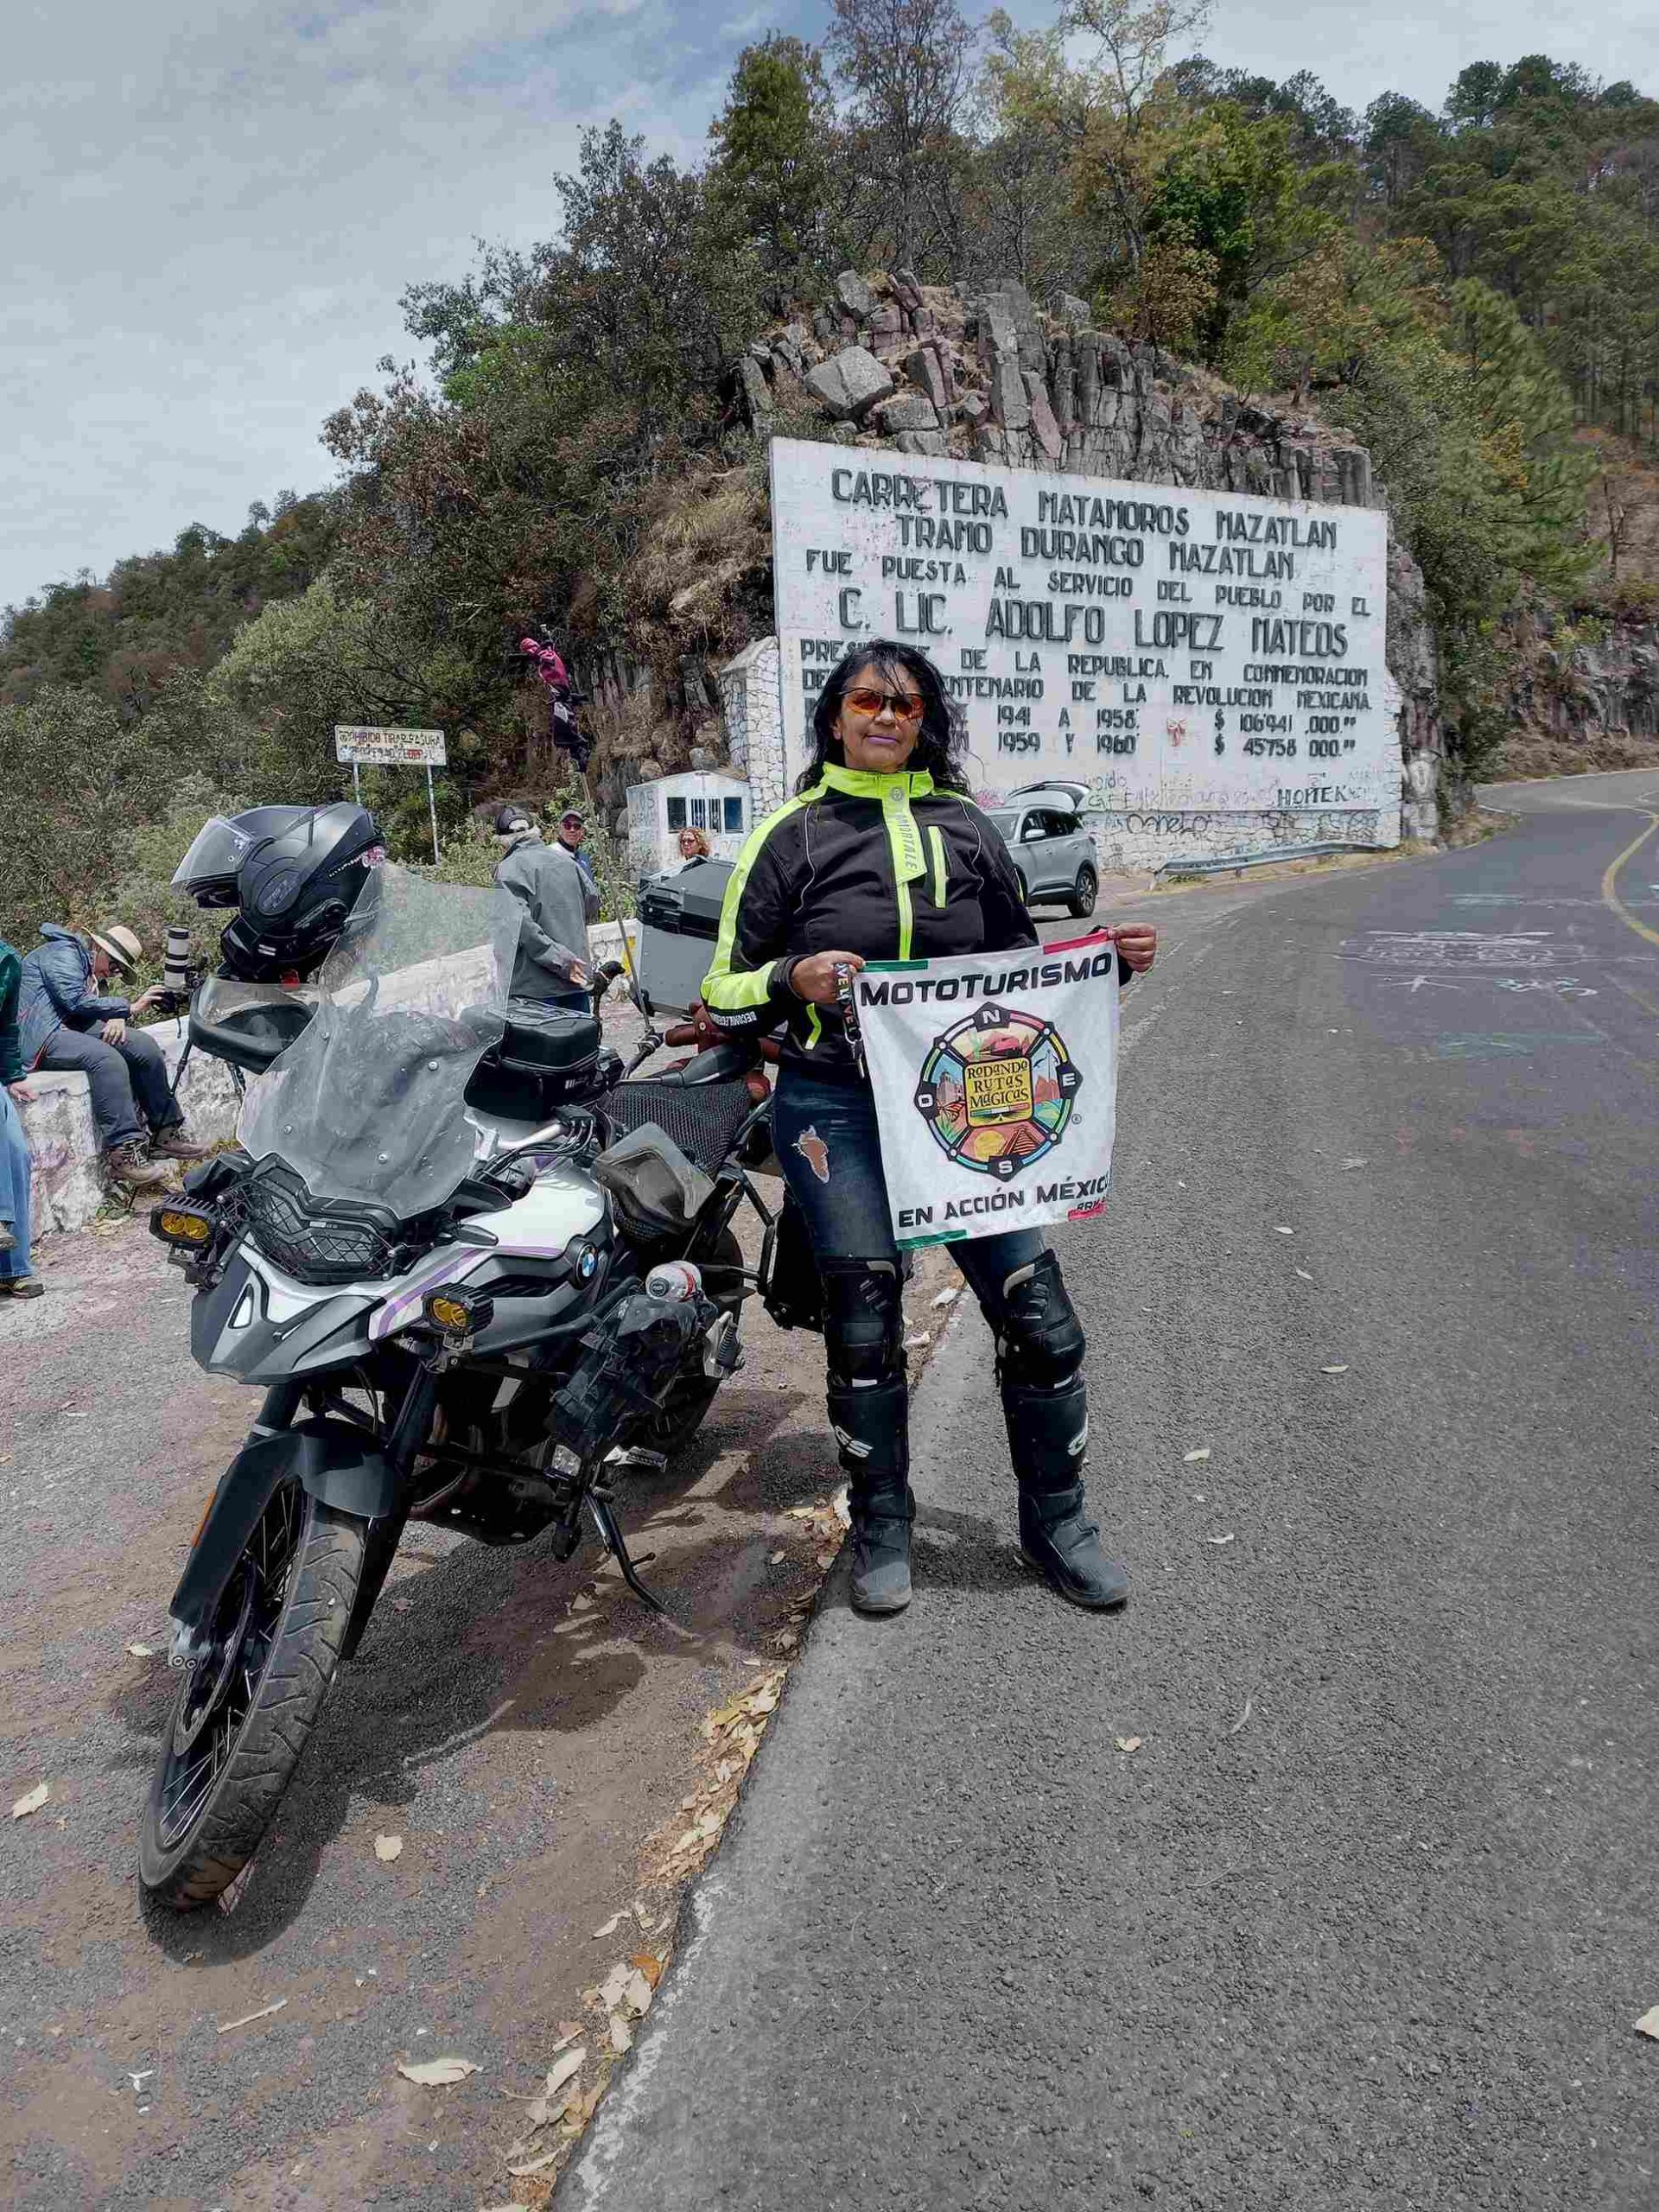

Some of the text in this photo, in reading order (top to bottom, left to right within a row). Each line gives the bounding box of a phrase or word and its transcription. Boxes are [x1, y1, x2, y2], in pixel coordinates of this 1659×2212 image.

[831, 468, 1337, 549] CARRETERA MATAMOROS MAZATLAN
[895, 513, 1294, 580] TRAMO DURANGO MAZATLAN
[806, 549, 1370, 616] FUE PUESTA AL SERVICIO DEL PUEBLO POR EL
[838, 587, 1349, 658] C. LIC. ADOLFO LOPEZ MATEOS
[961, 648, 988, 670] DE
[1015, 651, 1041, 672] LA
[1190, 660, 1213, 680] EN
[1243, 663, 1369, 687] CONMEMORACION
[1071, 681, 1096, 701] DE
[1123, 683, 1147, 702] LA
[1173, 684, 1274, 709] REVOLUCION
[997, 704, 1031, 727] 1941
[1058, 707, 1071, 728] A
[1214, 709, 1225, 731] $
[998, 731, 1040, 753] 1959
[1214, 733, 1225, 756] $
[860, 952, 1113, 1007] MOTOTURISMO
[982, 1009, 1001, 1024] N
[1063, 1072, 1077, 1087] E
[918, 1093, 934, 1108] O
[998, 1160, 1013, 1173] S
[898, 1206, 933, 1228] EN
[944, 1187, 1025, 1220] ACCIÓN
